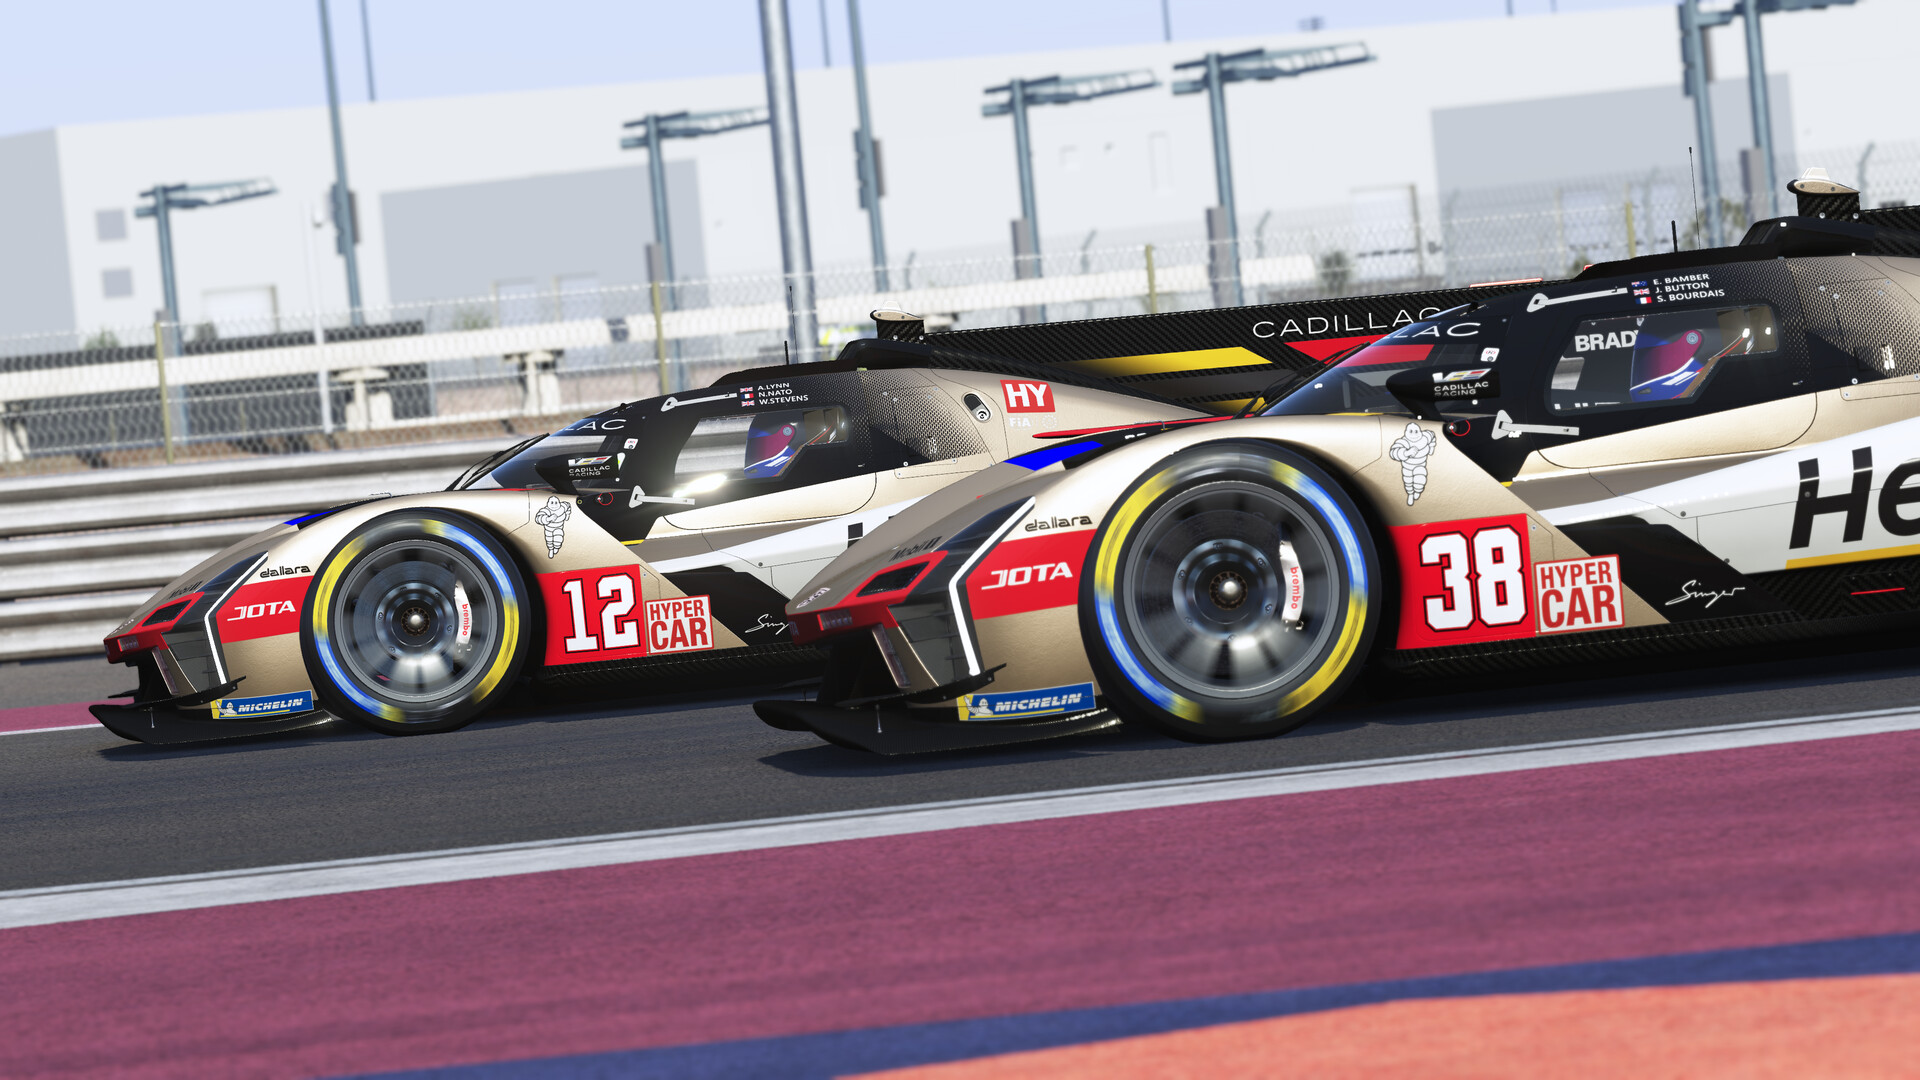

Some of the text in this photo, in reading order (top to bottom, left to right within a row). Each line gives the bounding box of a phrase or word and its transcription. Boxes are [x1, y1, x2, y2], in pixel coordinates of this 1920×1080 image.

[1653, 273, 1710, 286] E. BAMBER
[1664, 281, 1710, 293] BUTTON
[1657, 289, 1725, 303] S. BOURDAIS
[1574, 329, 1639, 352] BRAD
[758, 388, 793, 398] N.NATO
[1004, 383, 1047, 408] HY
[1433, 381, 1489, 392] CADILLAC
[759, 394, 809, 405] W.STEVENS
[568, 465, 611, 474] CADILLAC
[1025, 514, 1093, 532] dallara
[259, 565, 311, 579] dallara
[981, 562, 1073, 590] JOTA
[1419, 524, 1529, 632] 38
[1540, 560, 1613, 589] HYPER
[1290, 566, 1302, 610] brembo
[226, 600, 297, 622] JOTA
[561, 572, 641, 654] 12
[649, 600, 704, 621] HYPER
[1541, 585, 1618, 628] CAR
[461, 603, 471, 636] brembo
[649, 617, 710, 650] CAR
[237, 698, 304, 713] MICHELIN
[994, 692, 1083, 713] MICHELIN
